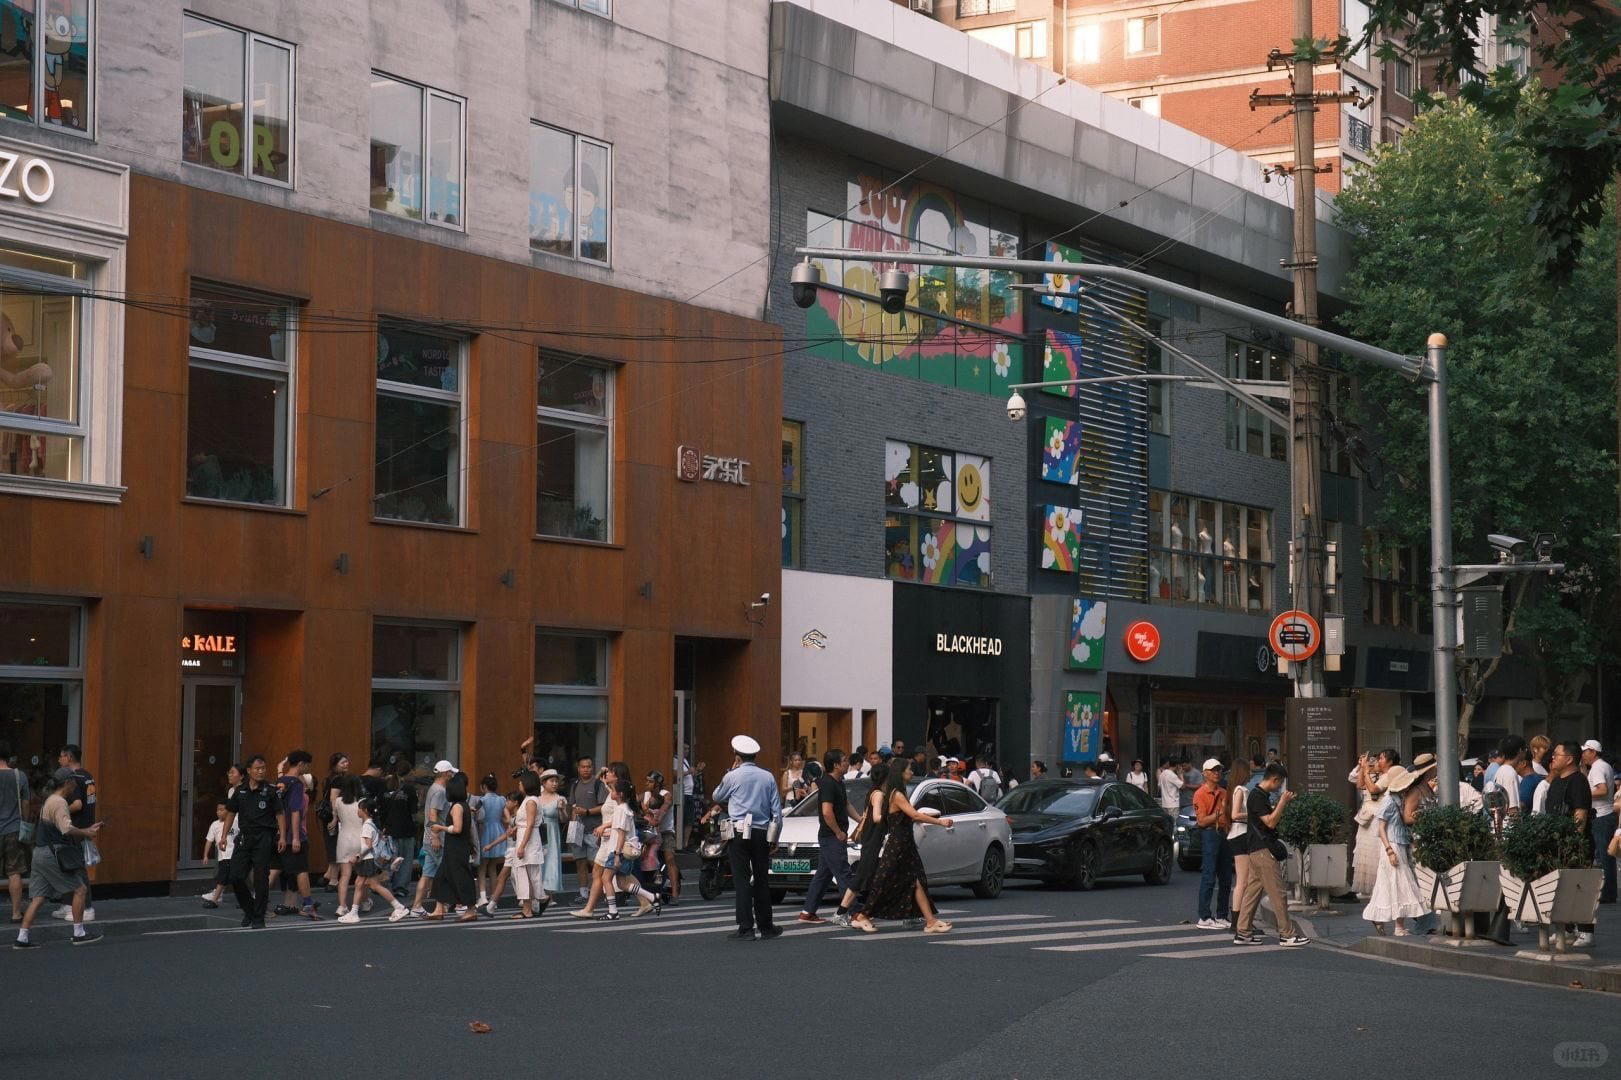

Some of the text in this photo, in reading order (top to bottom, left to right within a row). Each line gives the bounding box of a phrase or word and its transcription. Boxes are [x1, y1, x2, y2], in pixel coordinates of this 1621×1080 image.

[210, 121, 276, 173] OR
[193, 634, 236, 653] KALE
[936, 633, 1002, 656] BLACKHEAD
